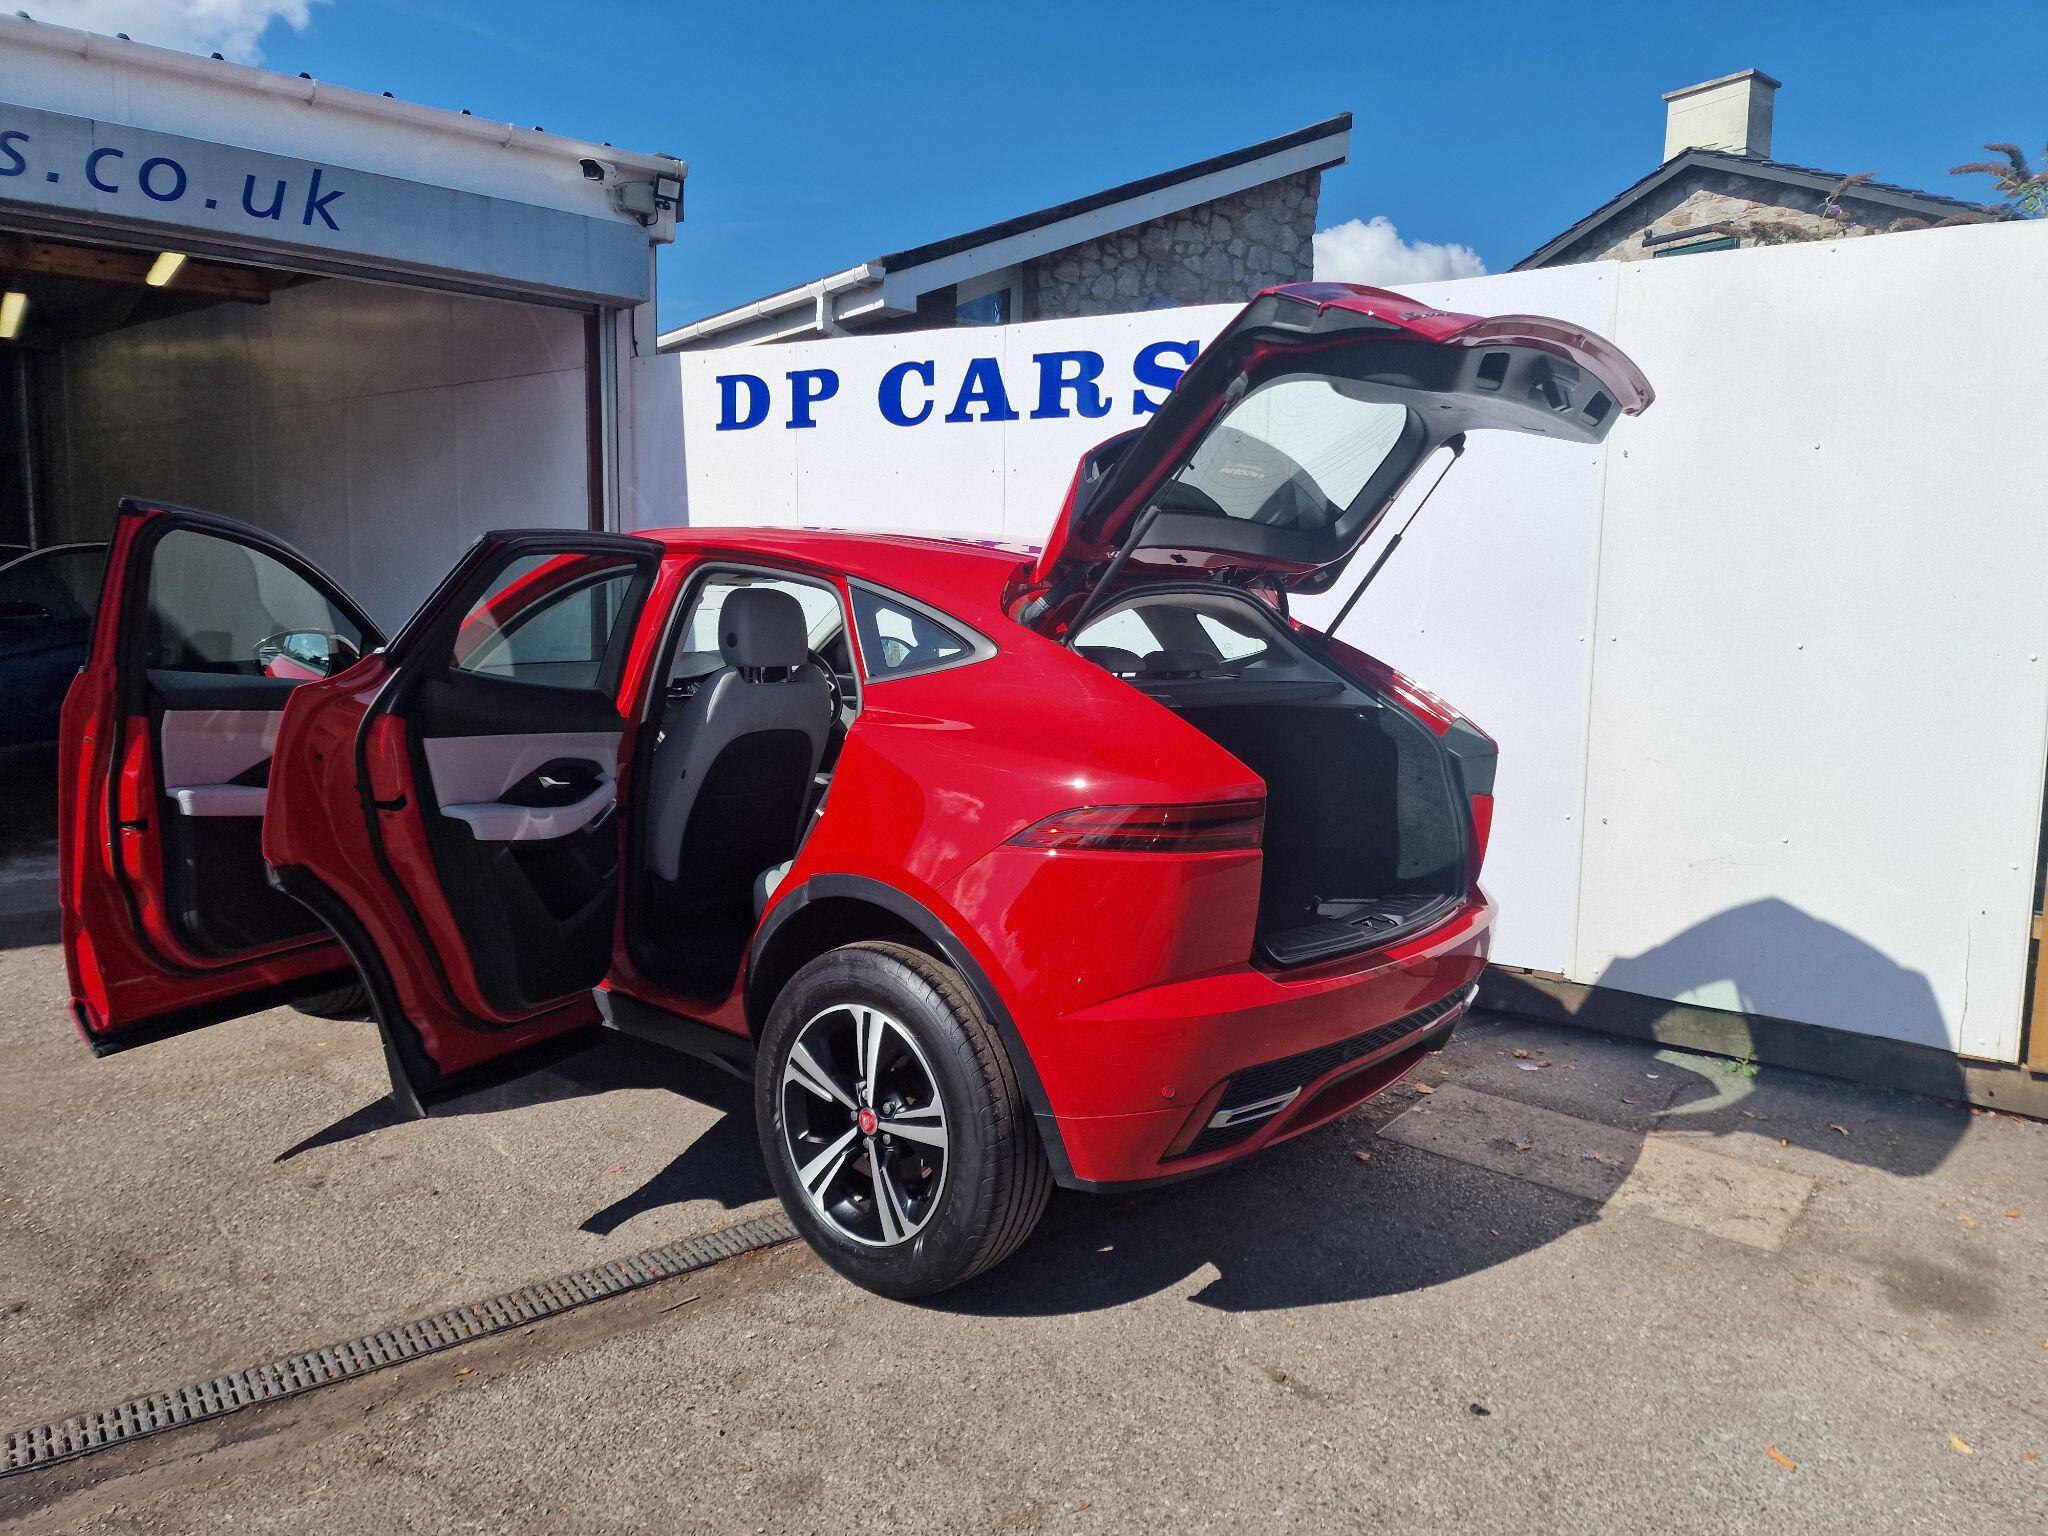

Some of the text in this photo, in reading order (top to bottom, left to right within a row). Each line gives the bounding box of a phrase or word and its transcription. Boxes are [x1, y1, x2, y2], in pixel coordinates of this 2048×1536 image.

[0, 130, 346, 232] s.co.uk
[715, 339, 1201, 431] DP CARS
